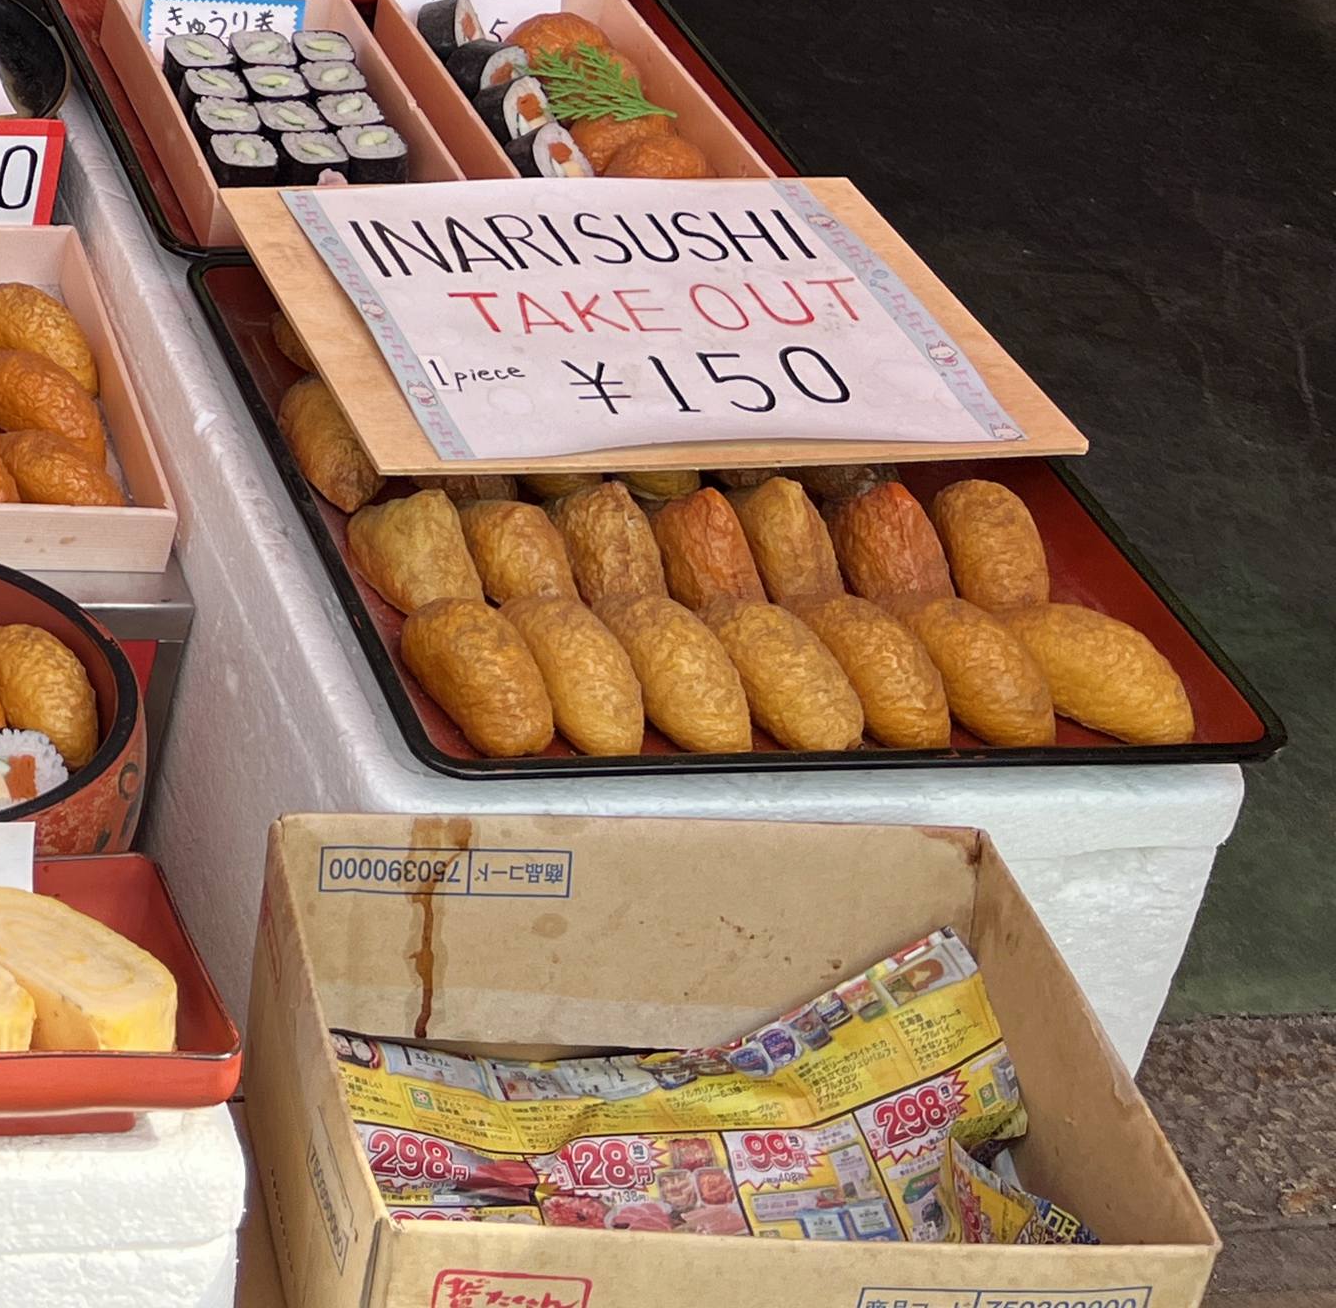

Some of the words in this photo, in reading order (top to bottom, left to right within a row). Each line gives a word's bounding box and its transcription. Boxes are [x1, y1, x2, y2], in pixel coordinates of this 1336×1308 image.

[447, 286, 681, 335] TAKE
[690, 276, 866, 332] OUT
[454, 362, 526, 386] piece
[559, 345, 851, 416] ¥150
[329, 857, 462, 883] 750390000
[475, 863, 565, 884] 商品コード
